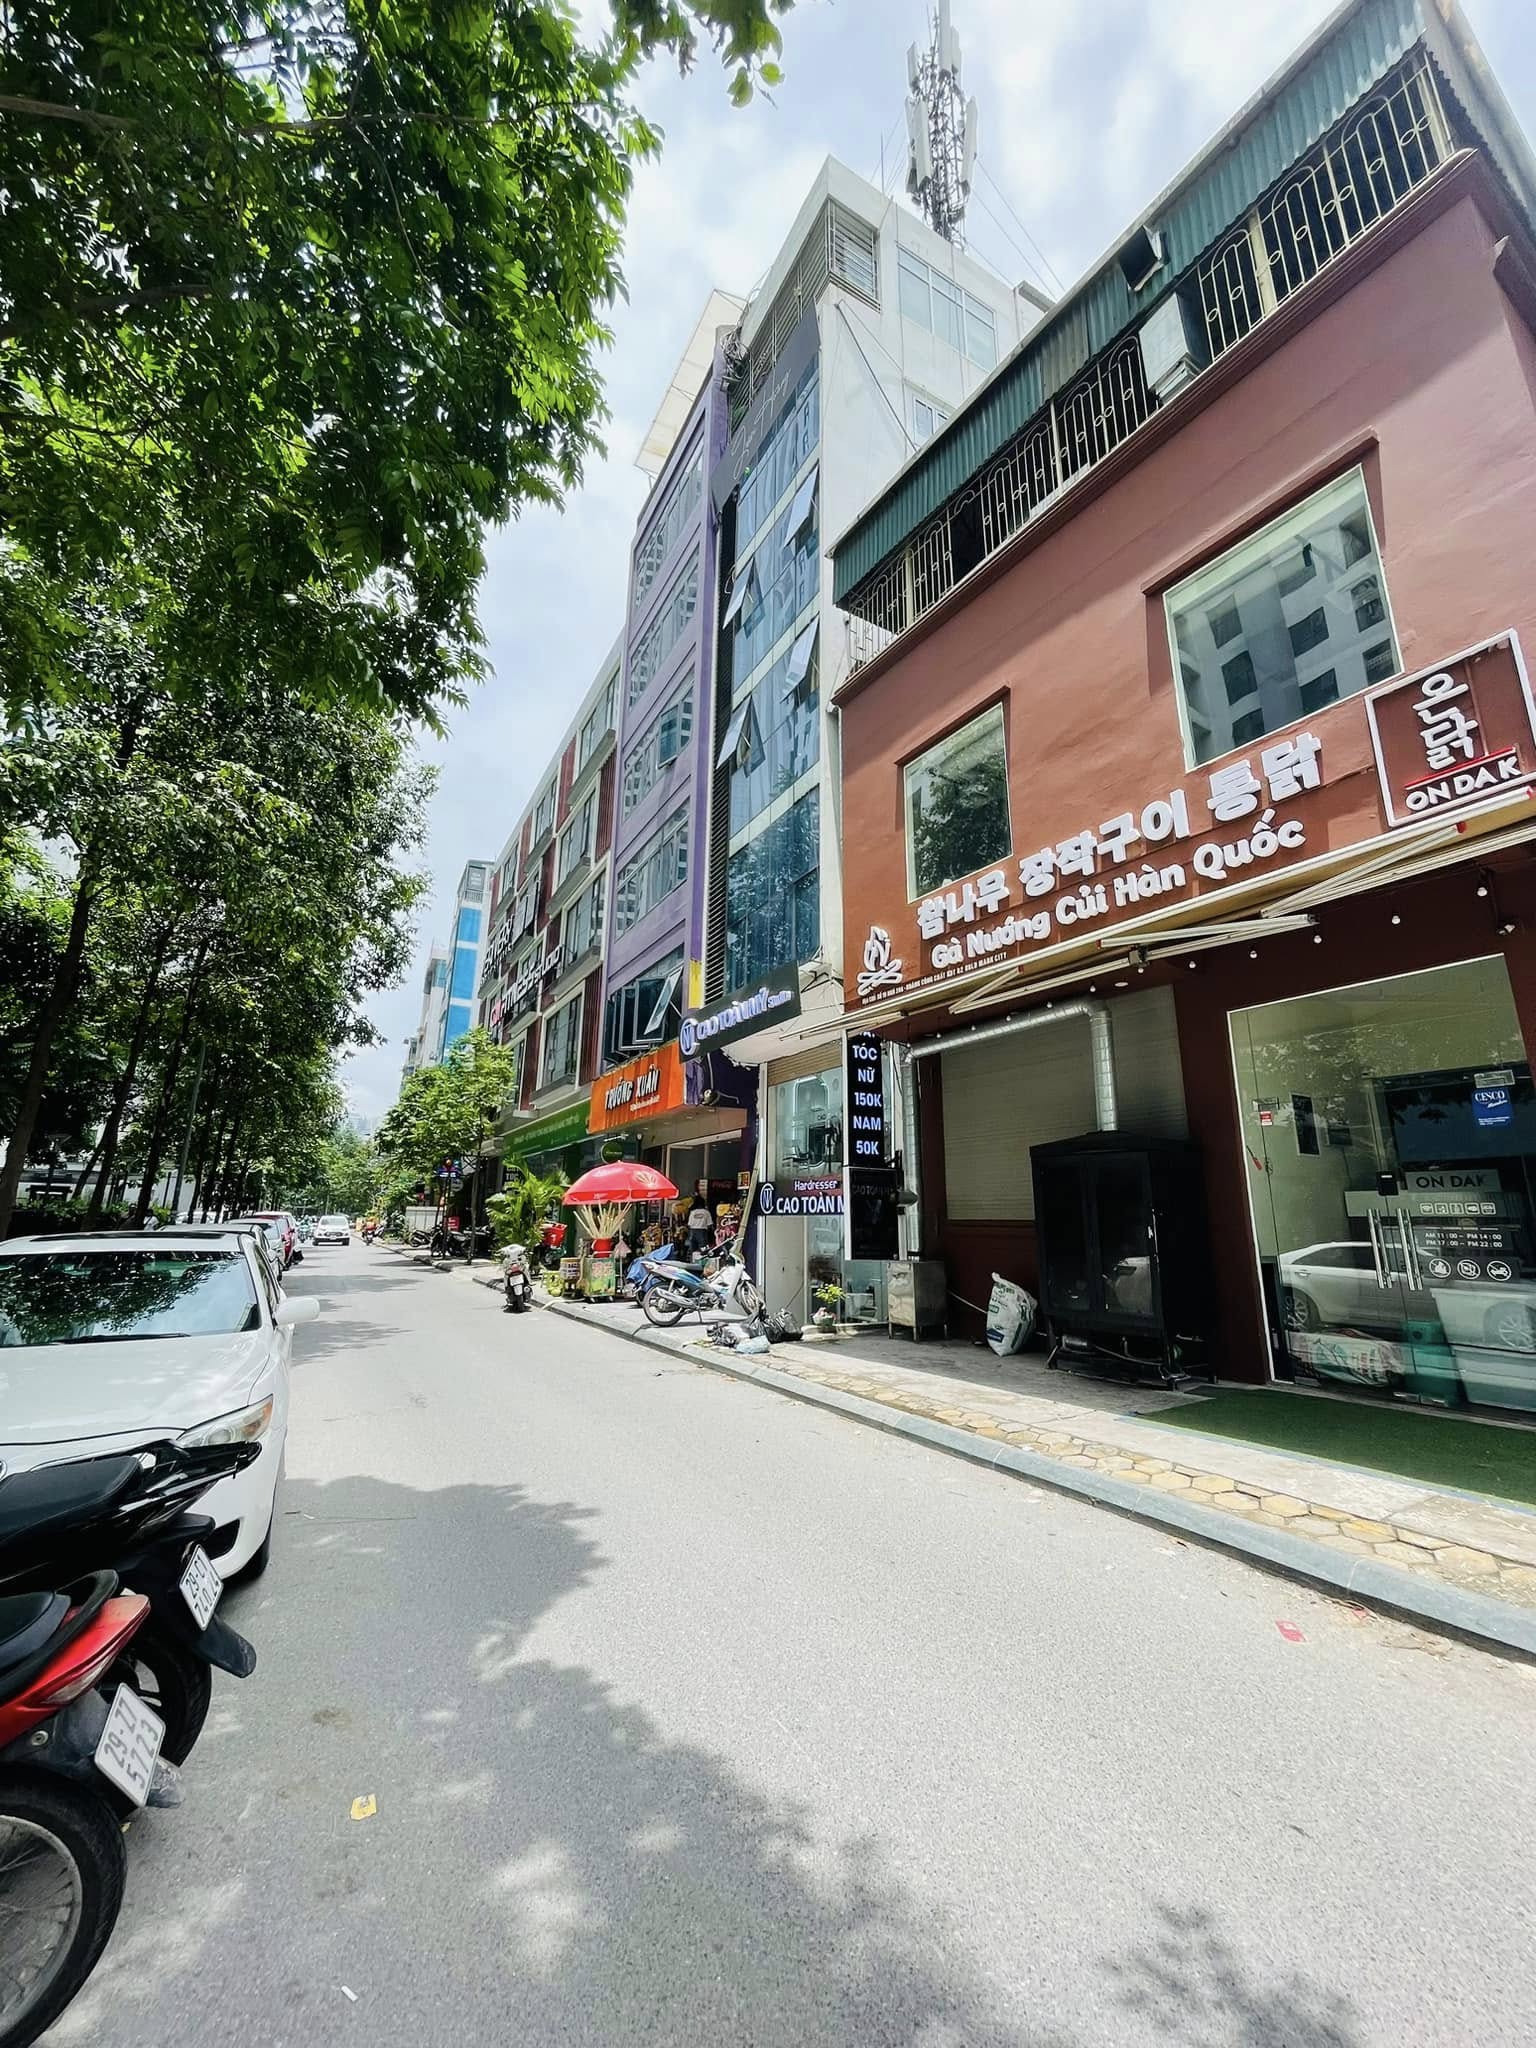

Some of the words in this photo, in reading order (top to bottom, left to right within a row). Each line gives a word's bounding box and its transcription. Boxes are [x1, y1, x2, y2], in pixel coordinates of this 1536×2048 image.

[1405, 781, 1451, 811] ON
[917, 870, 1010, 940] 참나무
[1019, 788, 1190, 897] 장작구이
[1206, 732, 1322, 822] 통닭
[931, 937, 964, 969] Gà
[966, 910, 1051, 958] Nướng
[1055, 884, 1110, 925] Củi
[1112, 863, 1187, 907] Hàn
[1193, 808, 1306, 880] Quốc
[852, 1042, 878, 1061] TÓC
[857, 1066, 876, 1084] NỮ
[854, 1092, 882, 1108] 150K
[1474, 1089, 1506, 1103] CESCO
[852, 1115, 882, 1131] NAM
[855, 1140, 880, 1156] 50K
[1416, 1176, 1445, 1189] ON
[776, 1197, 800, 1214] CAO
[803, 1192, 835, 1214] TOÀN
[104, 1696, 138, 1769] 29-Z7
[126, 1719, 159, 1790] 5723
